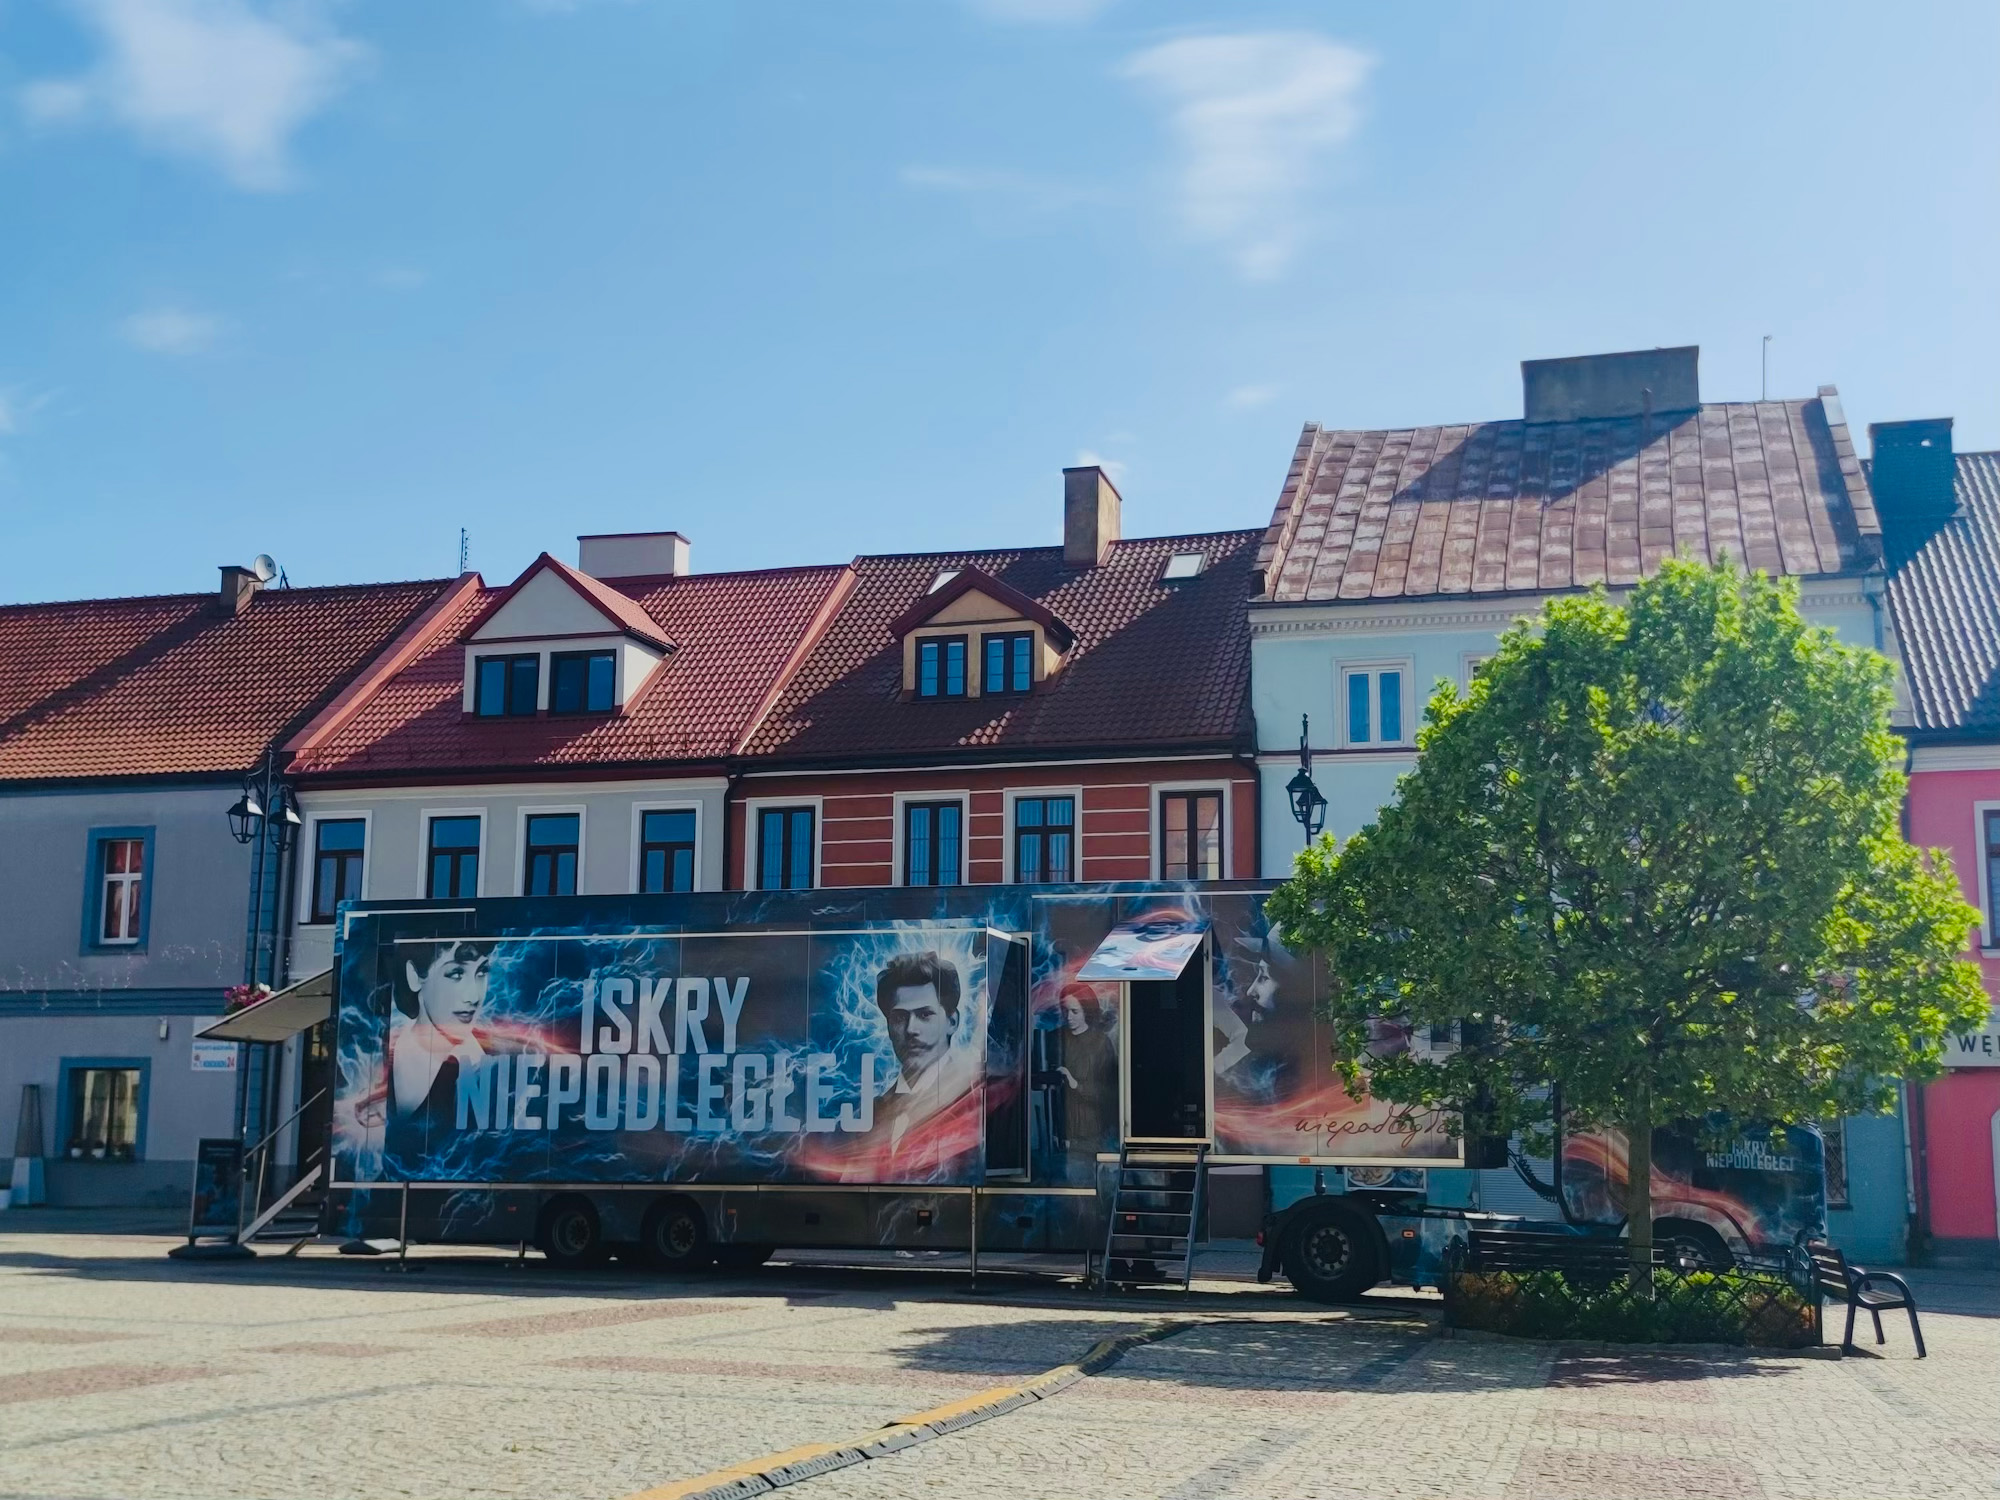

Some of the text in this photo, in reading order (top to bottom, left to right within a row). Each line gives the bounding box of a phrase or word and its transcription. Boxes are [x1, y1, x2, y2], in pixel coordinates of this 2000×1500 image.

[580, 976, 750, 1055] ISKRY
[1958, 1035, 2000, 1057] WĘ
[455, 1053, 875, 1132] NIEPODLEGŁEJ
